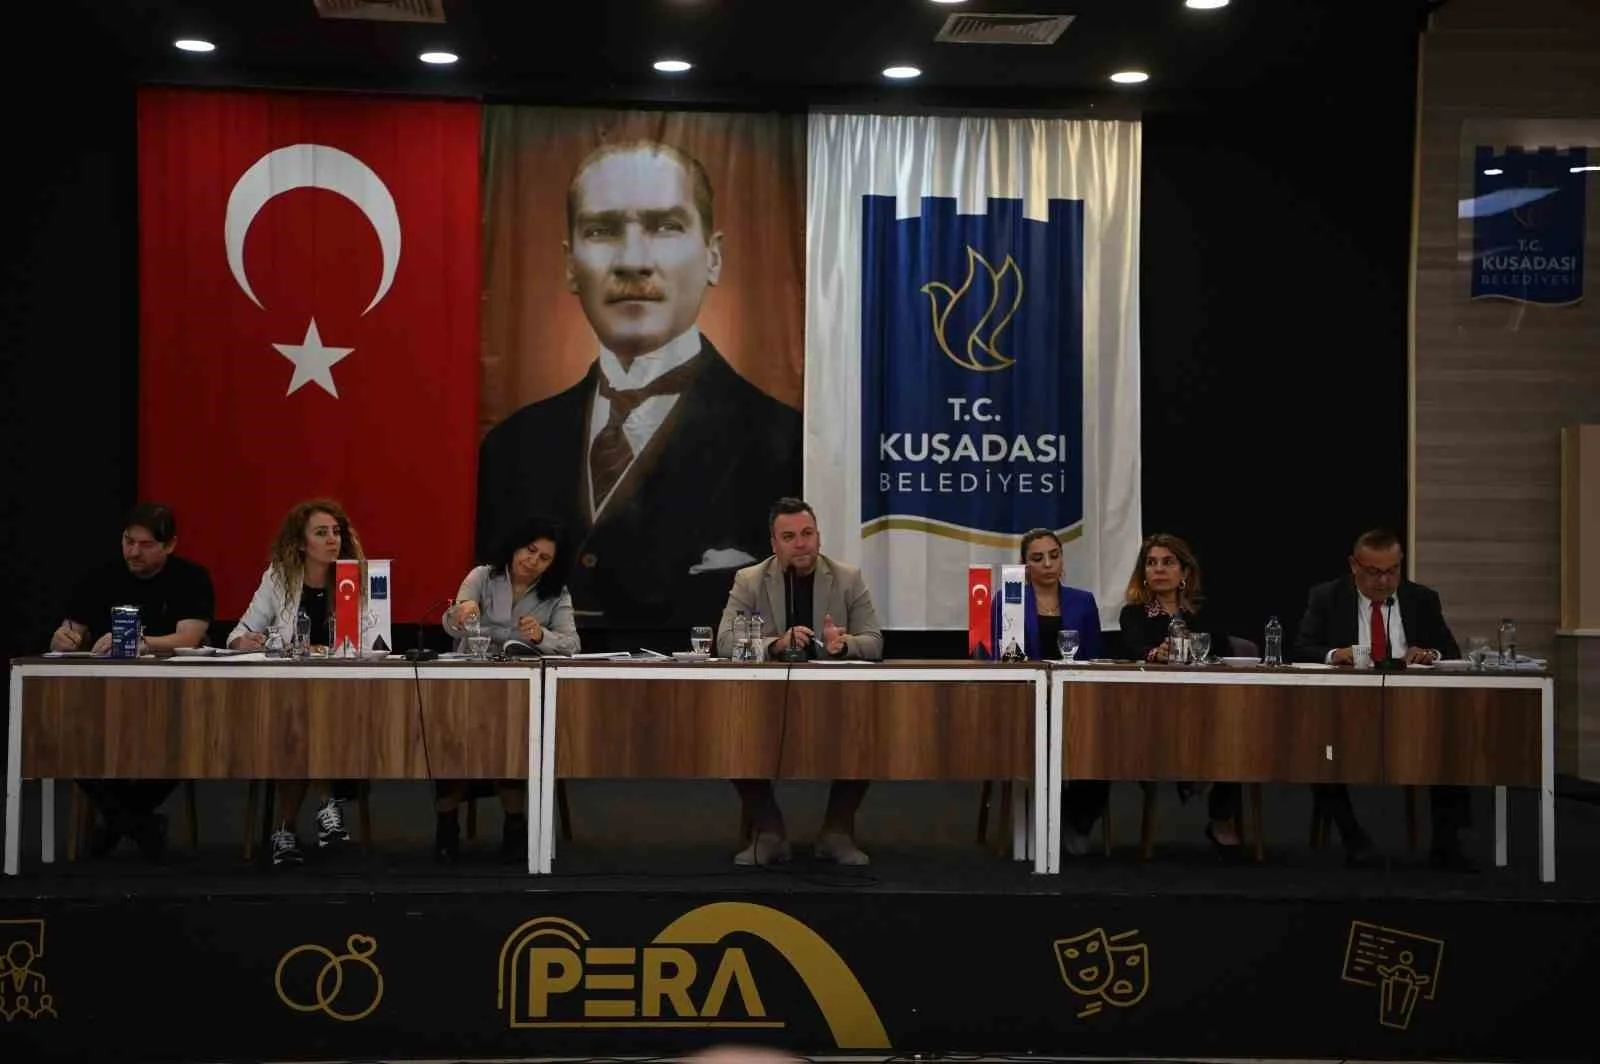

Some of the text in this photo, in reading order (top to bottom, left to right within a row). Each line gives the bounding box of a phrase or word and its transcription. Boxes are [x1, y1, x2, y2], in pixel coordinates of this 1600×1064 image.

[947, 398, 1001, 422] T.C.
[879, 433, 1066, 464] KUŞADASI
[879, 469, 1065, 494] BELEDİYESİ
[528, 947, 767, 1017] PERA
